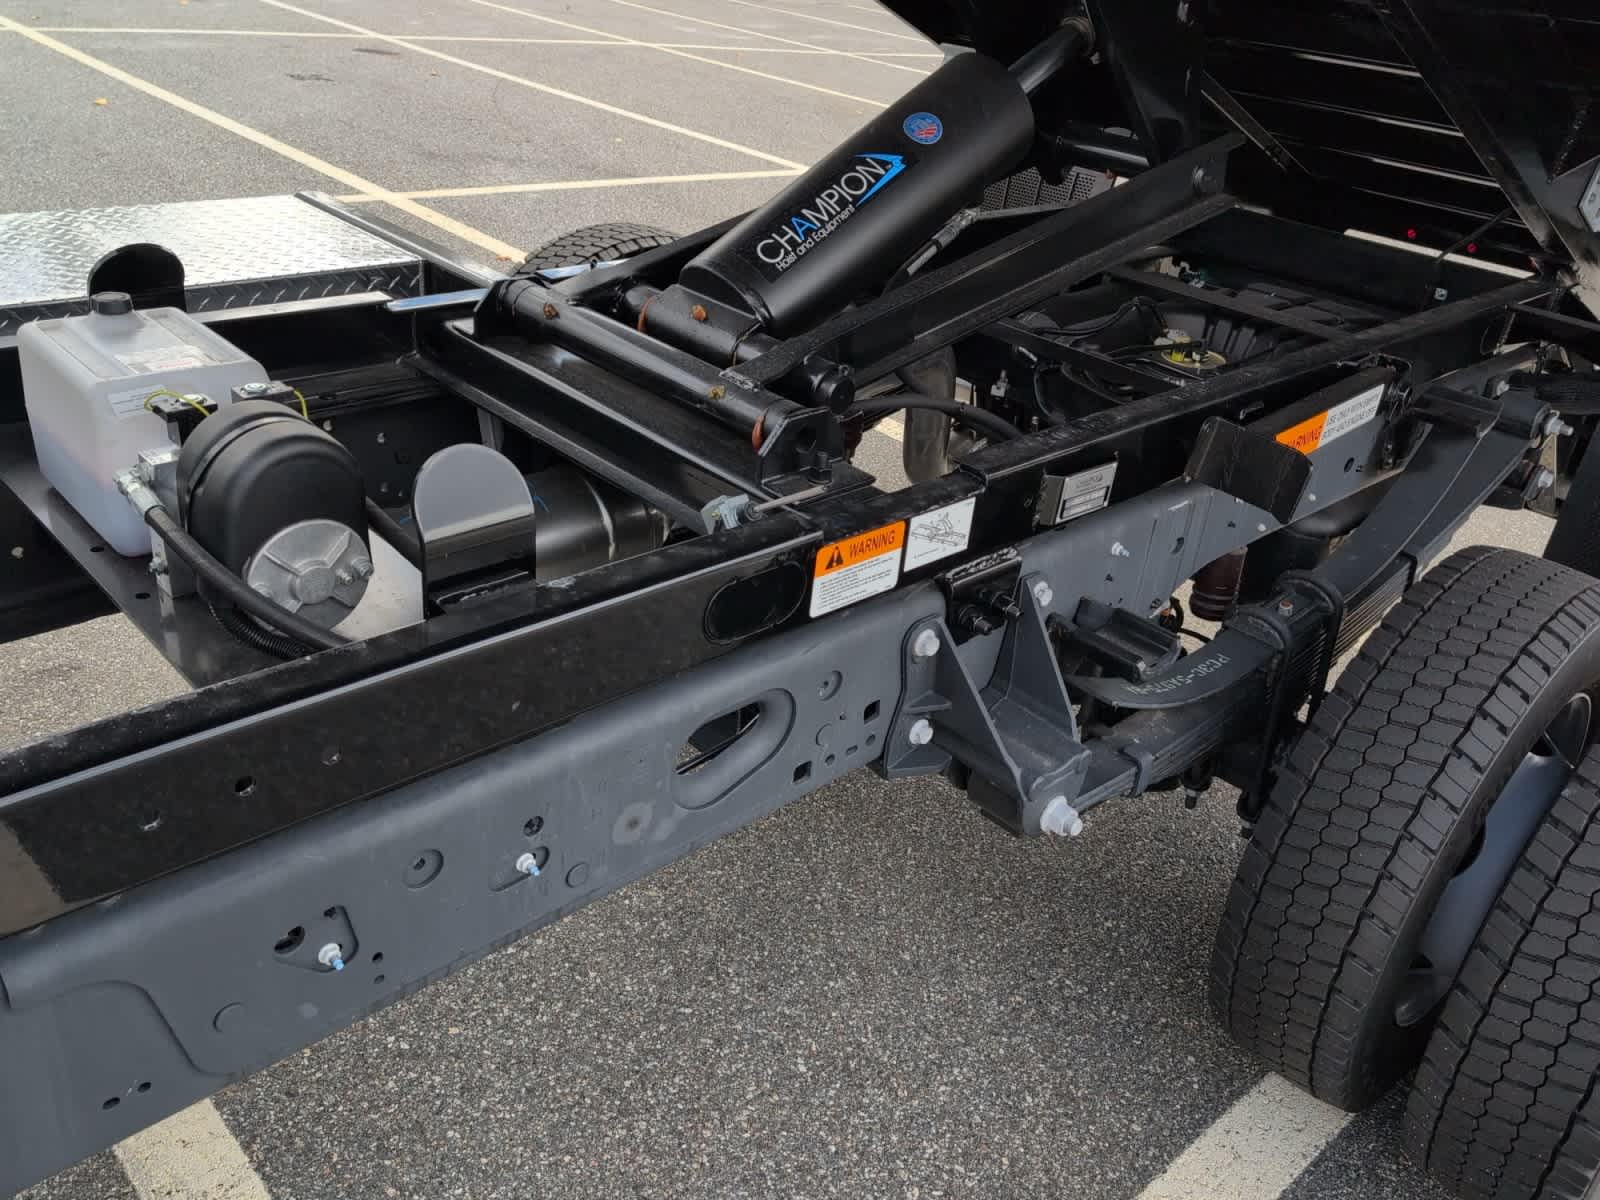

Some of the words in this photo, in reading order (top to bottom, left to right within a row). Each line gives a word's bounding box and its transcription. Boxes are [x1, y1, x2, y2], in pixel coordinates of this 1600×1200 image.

[756, 157, 887, 264] CHAMPION
[776, 248, 798, 272] Hoist
[797, 236, 814, 257] and
[812, 204, 856, 243] Equipment
[849, 529, 896, 558] WARNING
